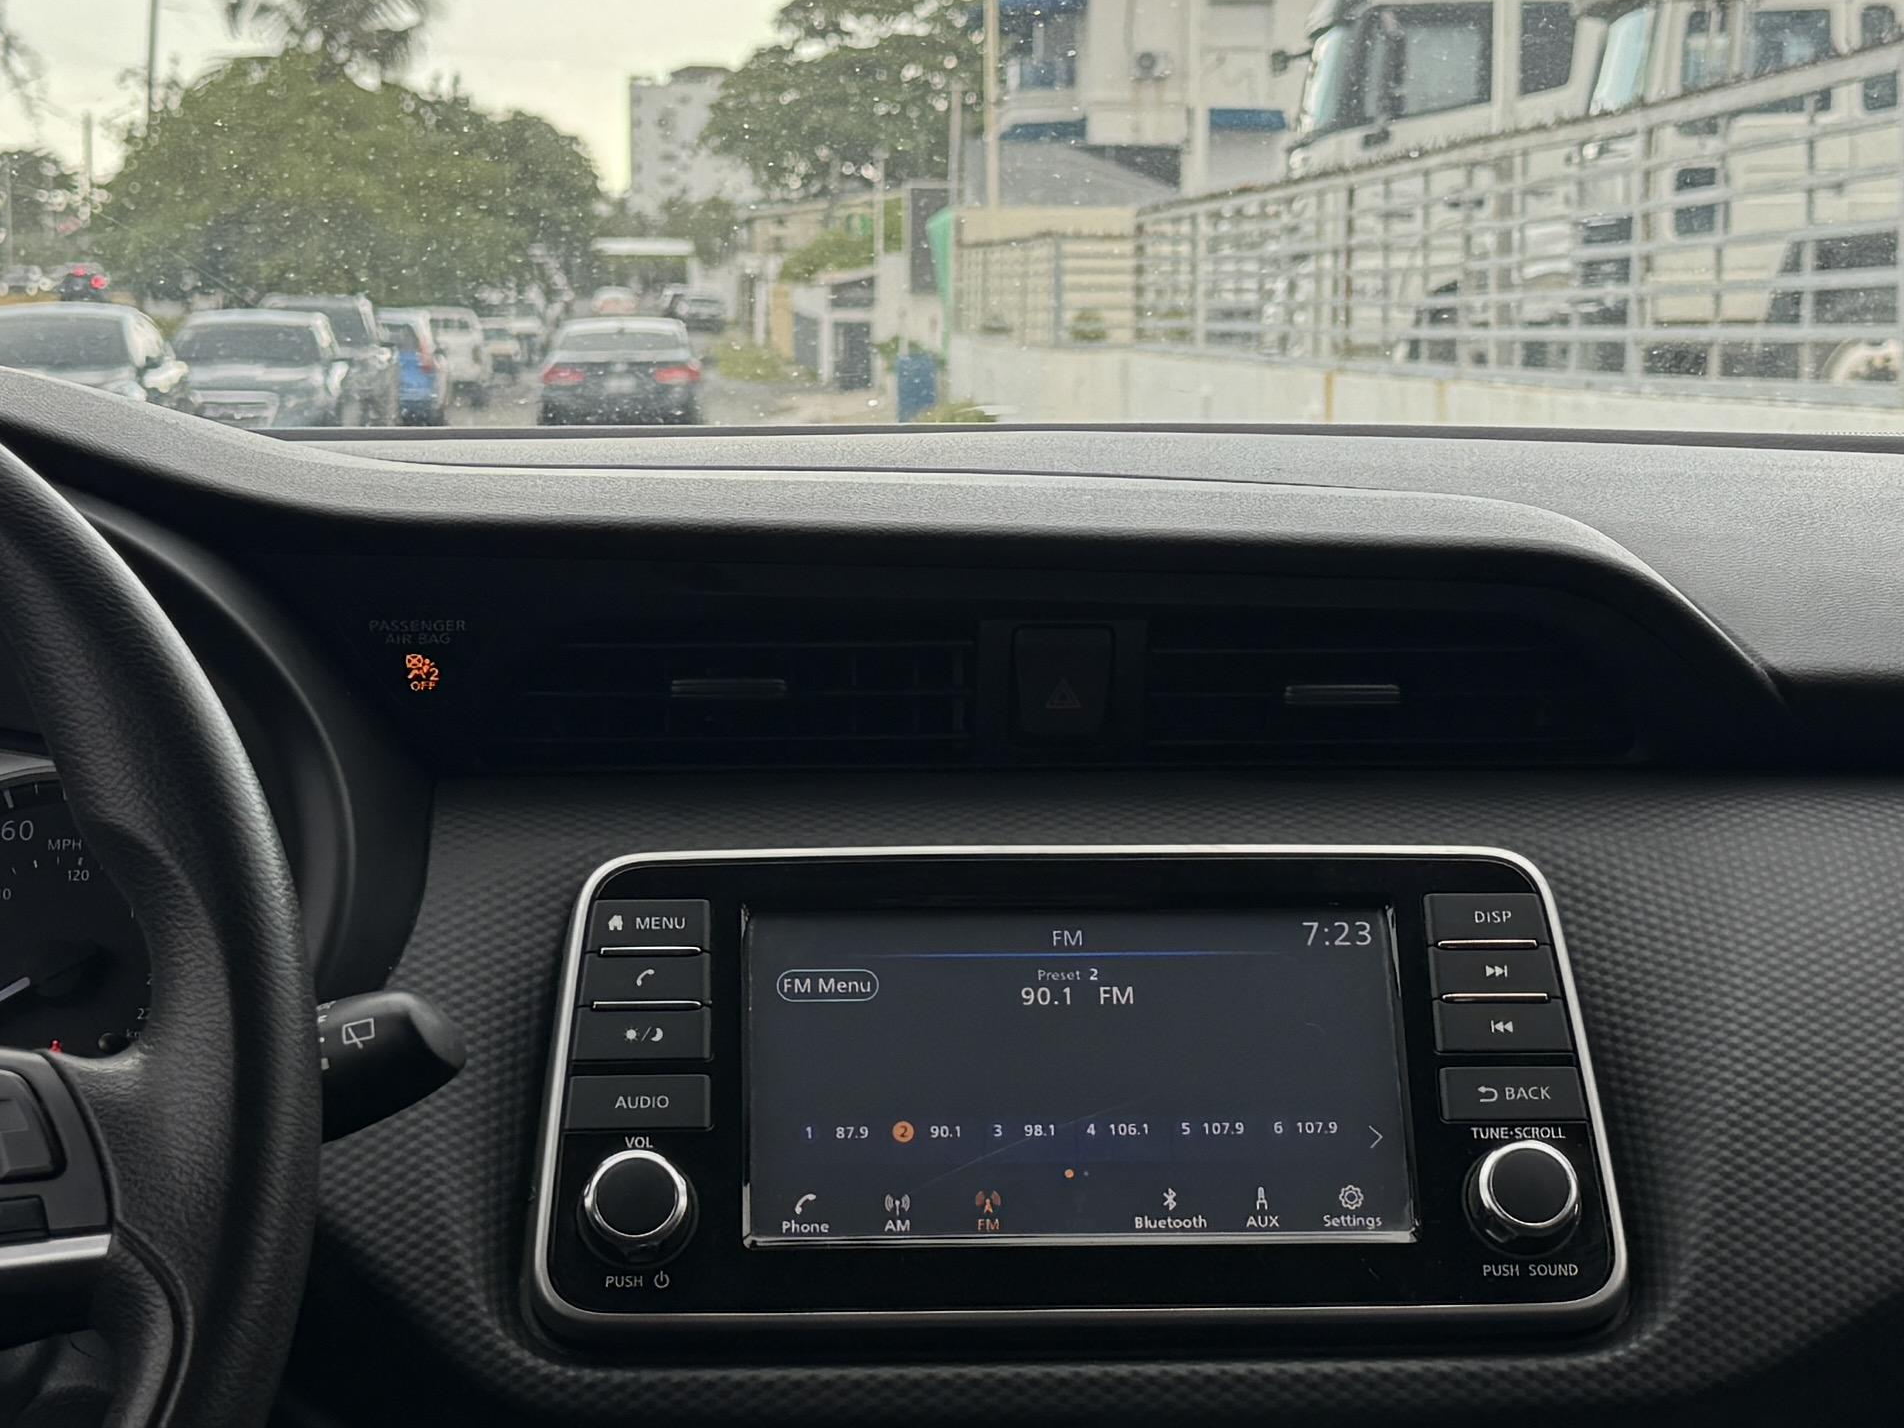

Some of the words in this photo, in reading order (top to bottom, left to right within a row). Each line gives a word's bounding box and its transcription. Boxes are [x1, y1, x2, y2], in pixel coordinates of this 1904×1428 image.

[368, 619, 467, 632] PASSENGER
[385, 633, 412, 645] AIR
[418, 633, 451, 645] BAG
[410, 681, 436, 692] OFF
[0, 820, 34, 841] 60
[47, 838, 83, 851] MPH
[67, 870, 90, 882] 120
[635, 916, 686, 930] MENU
[1474, 910, 1512, 923] DISP
[1052, 930, 1083, 946] FM
[1302, 922, 1372, 946] 7:23
[1038, 969, 1081, 981] Preset
[1089, 968, 1099, 980] 2
[783, 979, 812, 993] FM
[818, 978, 872, 994] Menu
[1021, 986, 1072, 1005] 90.1
[1099, 986, 1135, 1005] FM
[1505, 1086, 1551, 1101] BACK
[614, 1095, 670, 1109] AUDIO
[805, 1126, 814, 1140] 1
[836, 1126, 869, 1140] 87.9
[897, 1125, 909, 1139] 2
[930, 1125, 962, 1139] 90.1
[993, 1124, 1003, 1137] 3
[1024, 1124, 1056, 1138] 98.1
[1086, 1123, 1096, 1137] 4
[1109, 1122, 1150, 1136] 106.1
[1181, 1122, 1191, 1136] 5
[1203, 1122, 1245, 1136] 107.9
[1274, 1121, 1284, 1135] 6
[1296, 1121, 1339, 1135] 107.9
[625, 1136, 655, 1149] VOL
[782, 1220, 830, 1234] Phone
[884, 1219, 911, 1233] AM
[977, 1218, 1000, 1232] FM
[1134, 1215, 1208, 1230] Bluetooth
[1246, 1215, 1280, 1229] AUX
[1323, 1214, 1383, 1230] Settings
[1482, 1263, 1520, 1277] PUSH
[1528, 1263, 1579, 1278] SOUND
[605, 1275, 644, 1288] PUSH
